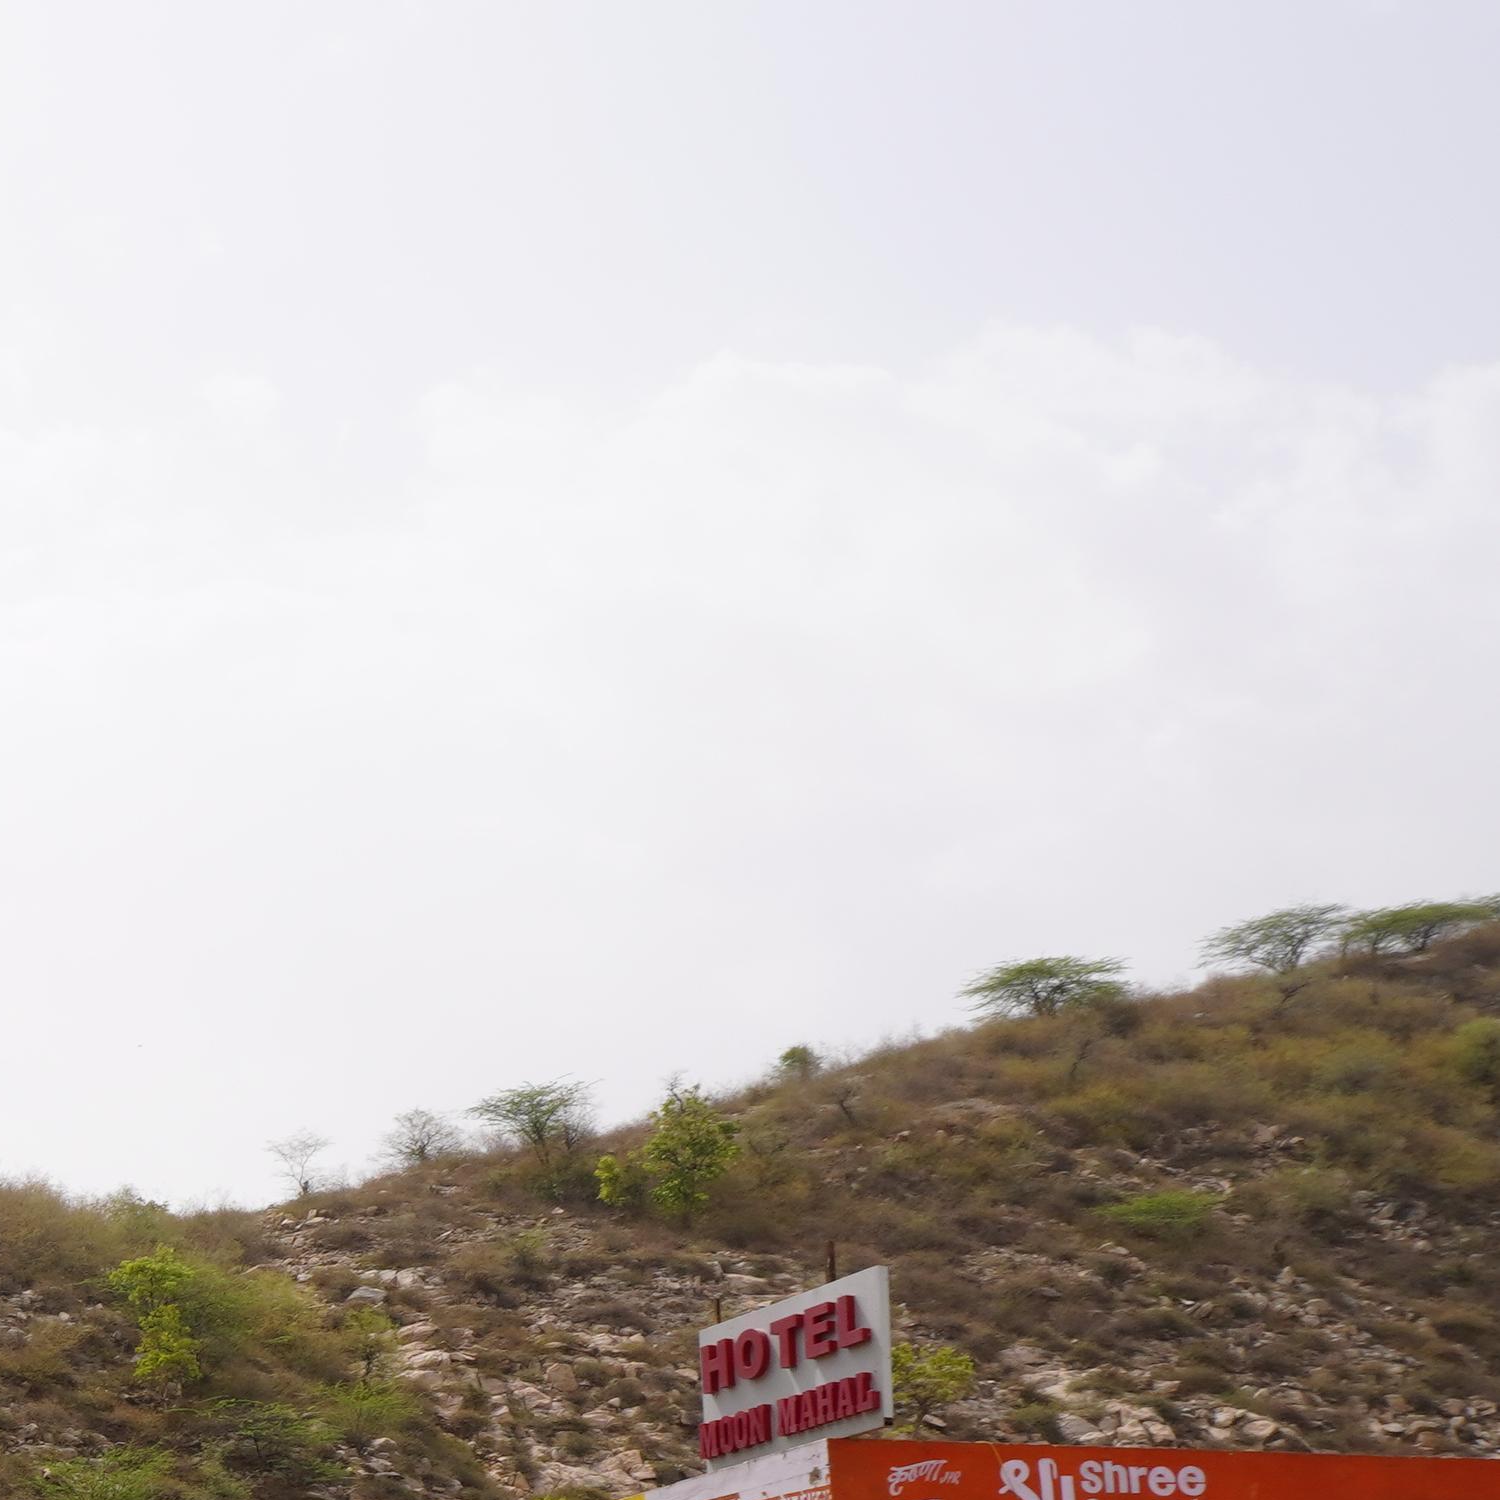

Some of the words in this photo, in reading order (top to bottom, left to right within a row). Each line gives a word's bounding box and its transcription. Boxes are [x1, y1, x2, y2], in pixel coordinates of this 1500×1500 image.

[701, 1295, 871, 1394] HOTEL
[699, 1404, 772, 1459] MOON
[777, 1372, 880, 1437] MAHAL
[1079, 1460, 1206, 1496] Shree
